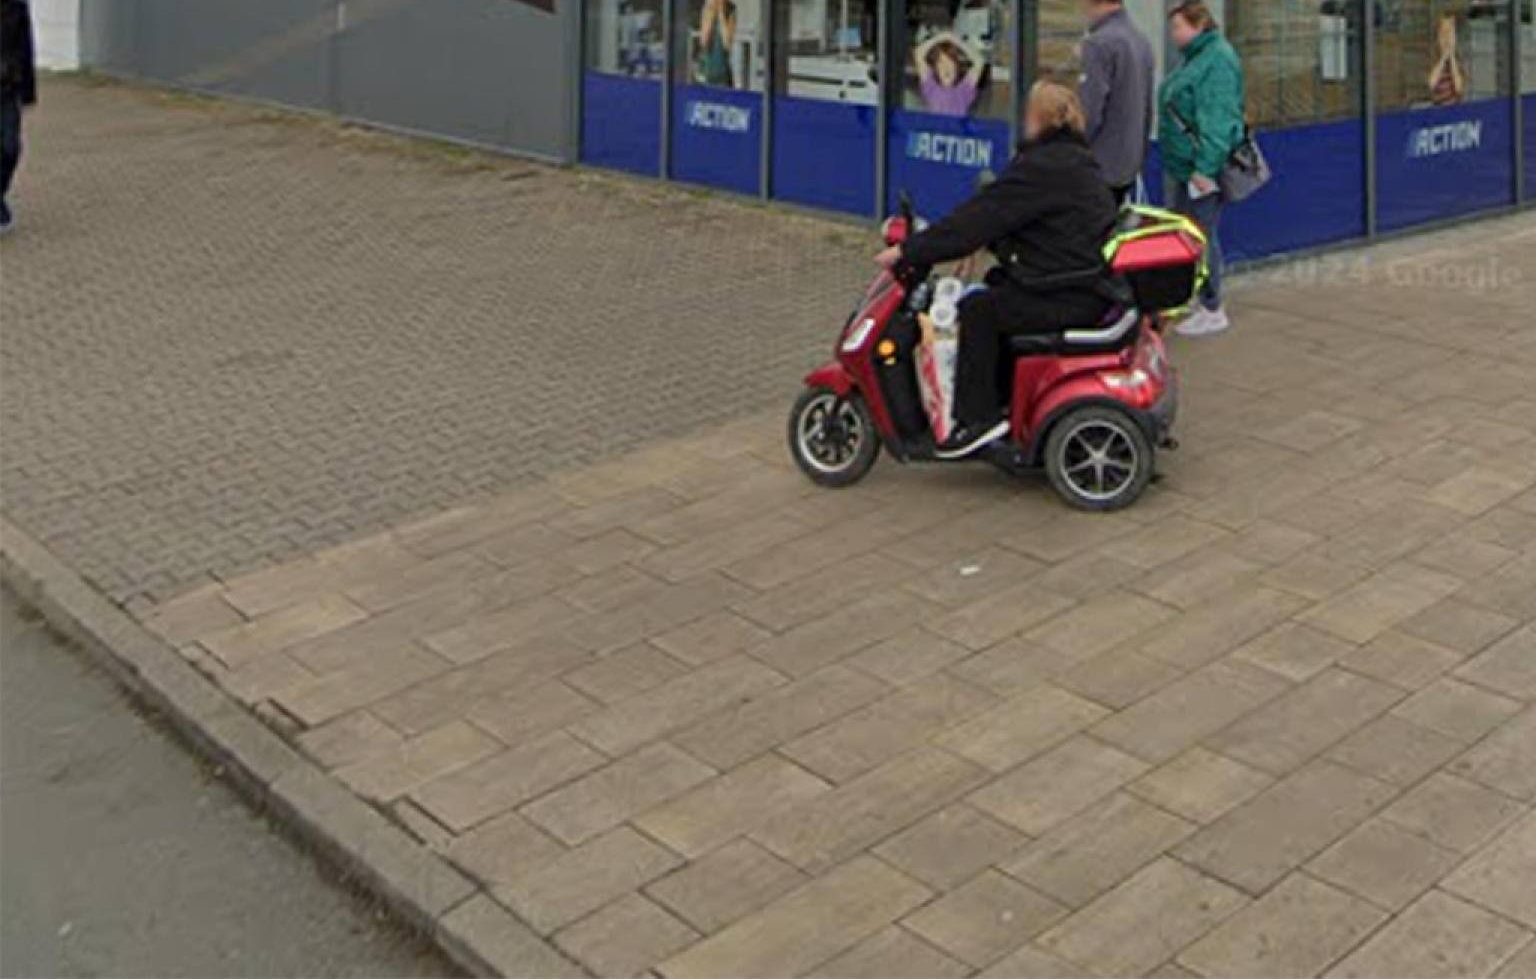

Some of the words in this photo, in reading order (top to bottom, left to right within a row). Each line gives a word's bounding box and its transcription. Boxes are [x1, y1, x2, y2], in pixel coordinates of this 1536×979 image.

[689, 102, 751, 132] ACTION
[914, 132, 993, 168] ACTION
[1416, 119, 1483, 157] ACTION
